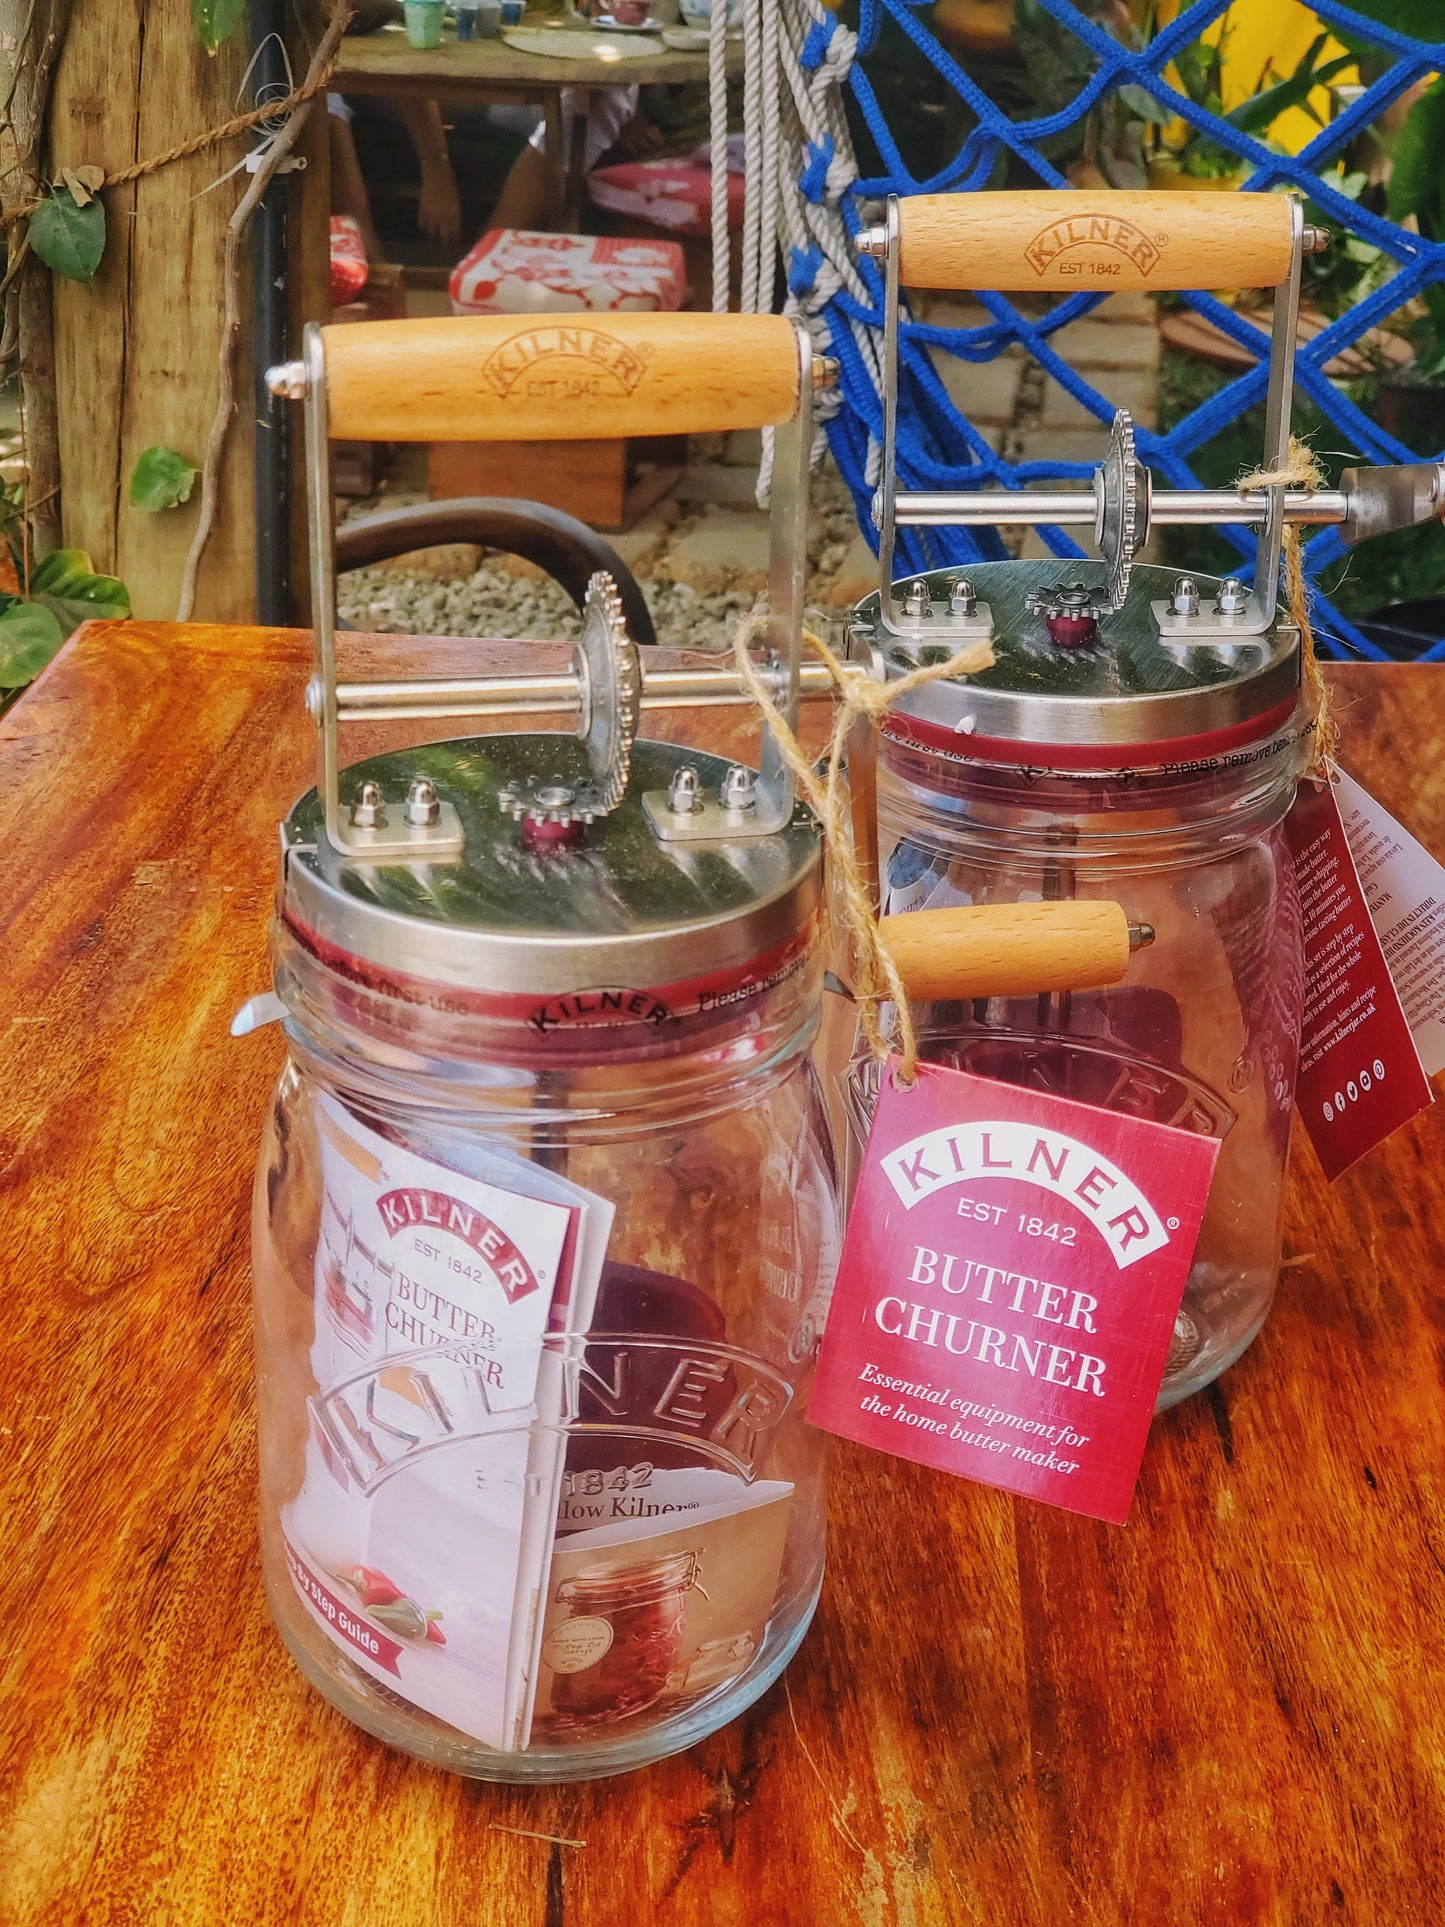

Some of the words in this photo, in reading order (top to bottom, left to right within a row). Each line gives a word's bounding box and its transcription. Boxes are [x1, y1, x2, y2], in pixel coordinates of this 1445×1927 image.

[1059, 262, 1085, 275] EST
[1089, 263, 1121, 276] 1842
[526, 379, 557, 397] EST
[1300, 849, 1309, 861] the
[1310, 839, 1320, 852] easy
[1320, 828, 1331, 842] way
[1308, 909, 1315, 920] 10
[1315, 894, 1336, 915] minutes
[1335, 884, 1346, 900] you
[1312, 889, 1321, 900] the
[1320, 874, 1337, 892] butter
[1319, 952, 1340, 975] selection
[1340, 946, 1346, 956] of
[1346, 932, 1364, 951] recipes
[1326, 939, 1336, 952] step
[1335, 933, 1343, 944] by
[1343, 923, 1353, 937] step
[1329, 972, 1338, 983] for
[1337, 965, 1347, 976] the
[1346, 951, 1361, 968] whole
[1312, 1007, 1319, 1016] to
[1318, 1000, 1327, 1011] use
[1326, 991, 1336, 1004] and
[1350, 998, 1360, 1012] and
[1360, 986, 1376, 1004] recipe
[956, 1197, 1007, 1226] EST
[1017, 1213, 1078, 1248] 1842
[413, 1237, 442, 1263] EST
[447, 1255, 483, 1285] 1842
[396, 1271, 496, 1340] BUTTER
[906, 1245, 1098, 1335] BUTTER
[874, 1296, 1107, 1398] CHURNER
[857, 1363, 948, 1408] Essential
[949, 1394, 1055, 1440] equipment
[1048, 1423, 1090, 1450] for
[859, 1394, 891, 1419] the
[891, 1404, 946, 1437] home
[948, 1418, 1010, 1455] butter
[1010, 1440, 1080, 1475] maker
[338, 1611, 380, 1655] Guide
